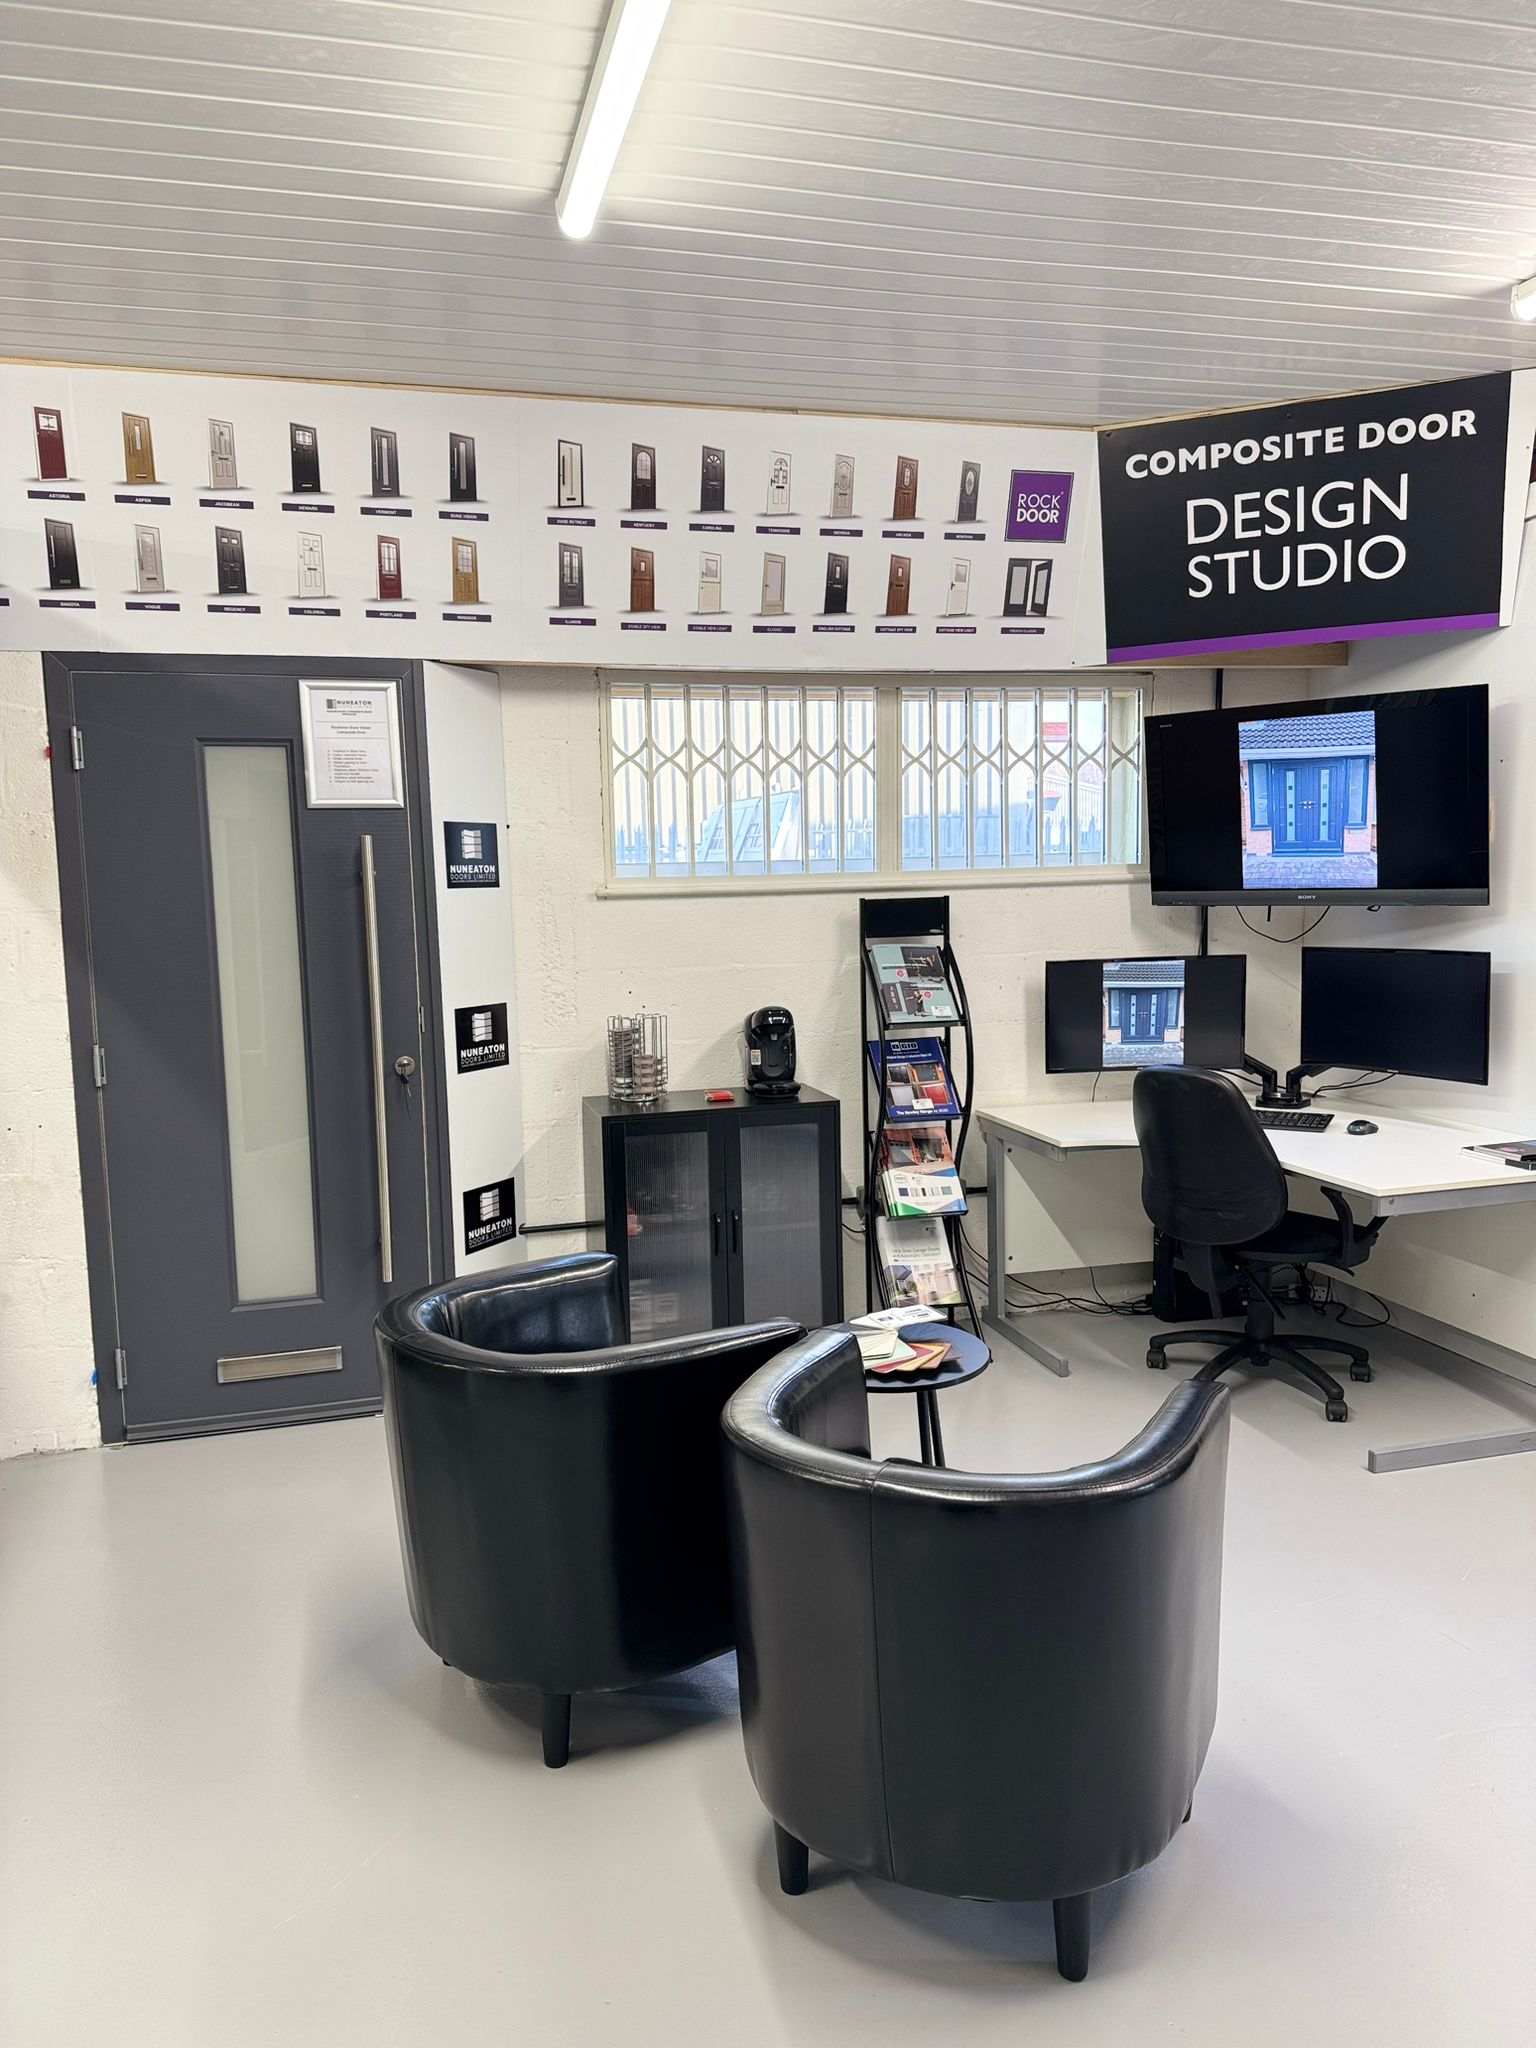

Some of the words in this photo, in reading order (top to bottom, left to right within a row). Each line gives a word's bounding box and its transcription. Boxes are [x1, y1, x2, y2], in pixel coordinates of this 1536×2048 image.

[1125, 426, 1344, 479] COMPOSITE
[1358, 409, 1477, 450] DOOR
[1018, 493, 1061, 509] ROCK
[1186, 472, 1409, 546] DESIGN
[1016, 508, 1059, 523] DOOR
[1188, 534, 1407, 599] STUDIO
[450, 864, 496, 873] NUNEATON
[460, 1043, 505, 1058] NUNEATON
[461, 1056, 481, 1065] DOORS
[484, 1052, 505, 1061] LIMITED
[468, 1217, 512, 1240] NUNEATON
[469, 1234, 489, 1245] DOORS
[491, 1226, 512, 1238] LIMITED
